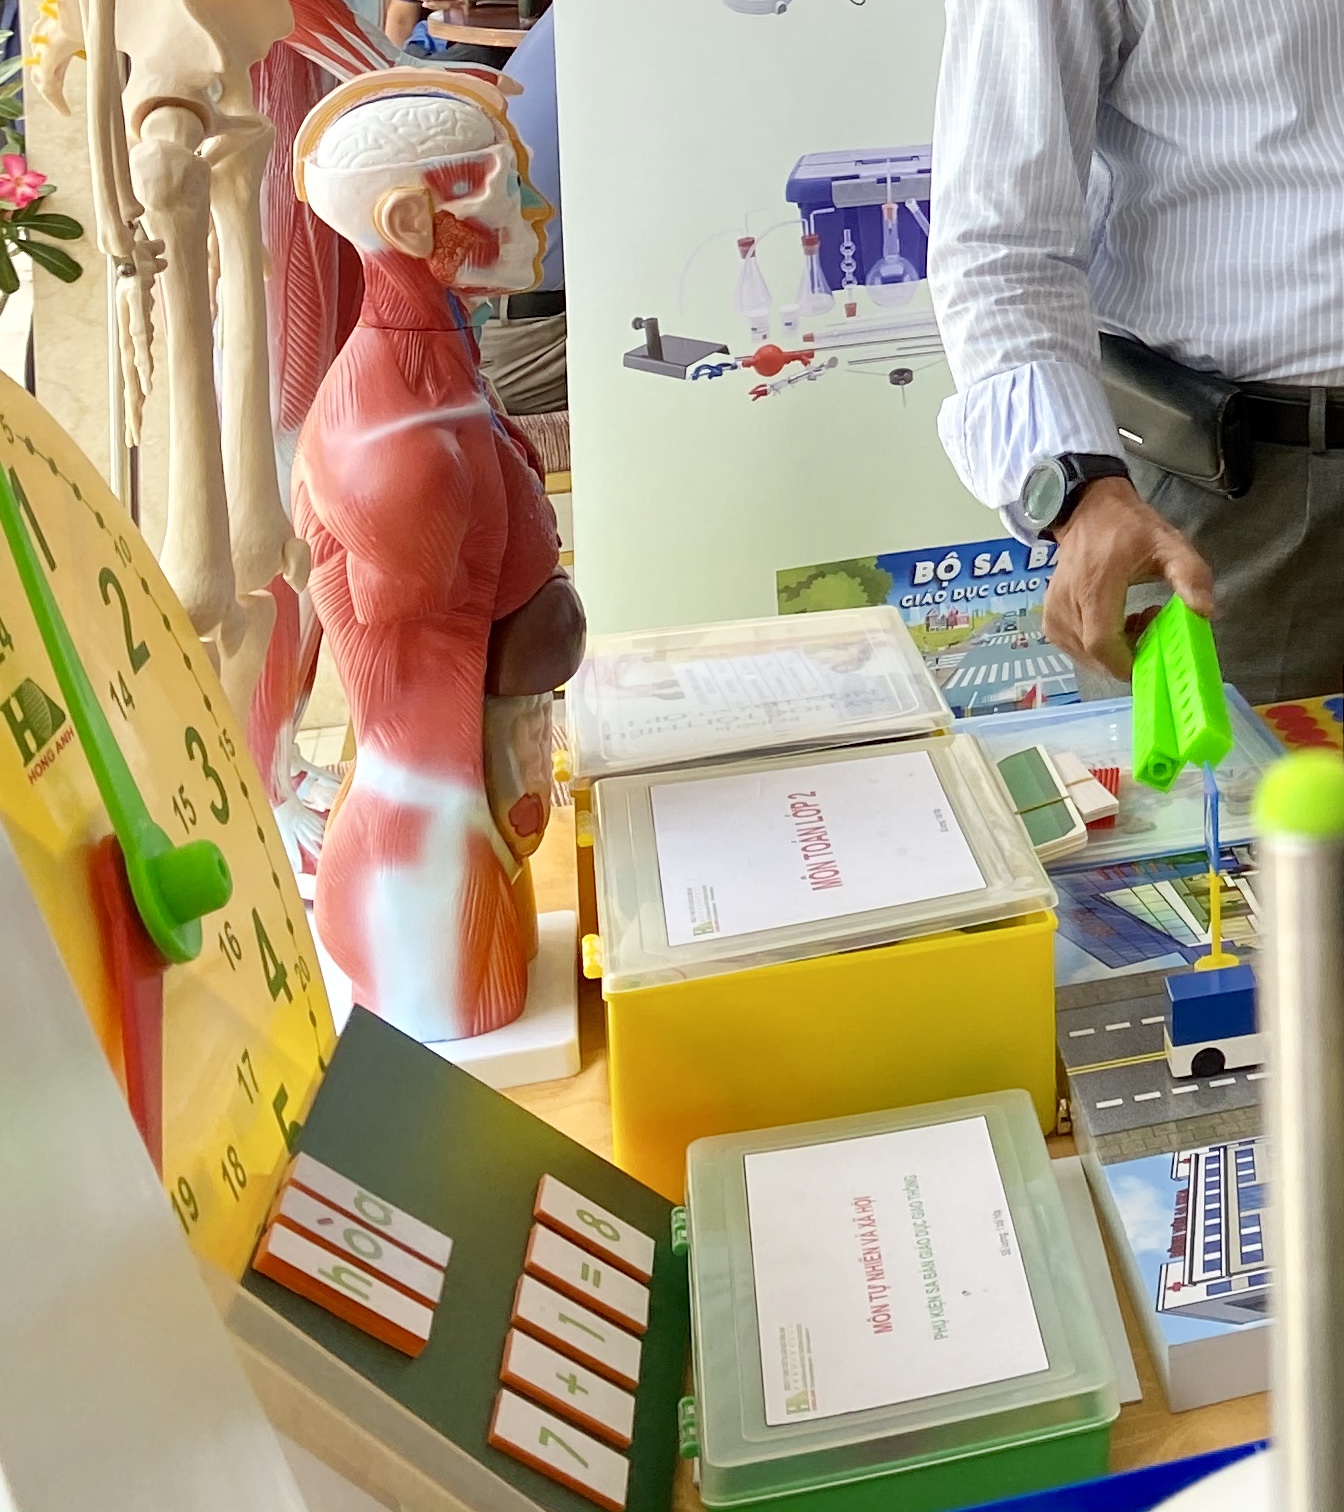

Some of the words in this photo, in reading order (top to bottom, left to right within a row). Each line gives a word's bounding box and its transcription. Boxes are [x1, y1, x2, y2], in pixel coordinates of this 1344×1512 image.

[113, 535, 132, 569] 10
[913, 550, 961, 587] BỘ
[973, 550, 1013, 577] SA
[901, 587, 948, 609] GIÁO
[952, 583, 989, 603] DỤC
[996, 576, 1040, 597] GIAO
[98, 566, 151, 676] 2
[108, 670, 136, 721] 14
[27, 749, 55, 786] HONG
[53, 725, 76, 754] ANH
[218, 728, 236, 763] 15
[184, 725, 230, 825] 3
[171, 784, 197, 835] 15
[787, 790, 817, 800] 2
[784, 801, 824, 826] LỚP
[791, 825, 834, 861] TOÁN
[801, 859, 844, 891] MÔN
[217, 920, 243, 972] 16
[251, 906, 294, 1005] 4
[294, 954, 311, 993] 20
[235, 1048, 260, 1105] 17
[221, 1143, 248, 1203] 18
[902, 1174, 920, 1201] THÔNG
[170, 1175, 200, 1236] 19
[851, 1195, 877, 1214] HỘI
[852, 1214, 876, 1228] XÃ
[909, 1200, 925, 1220] GIAO
[855, 1229, 879, 1246] VÀ
[913, 1237, 934, 1260] GIÁO
[858, 1246, 885, 1282] NHIÊN
[918, 1260, 938, 1281] BÀN
[867, 1284, 892, 1303] TỰ
[925, 1279, 940, 1295] SA
[866, 1303, 893, 1335] MÔN
[538, 1425, 589, 1469] 7
[576, 1208, 620, 1242] 8
